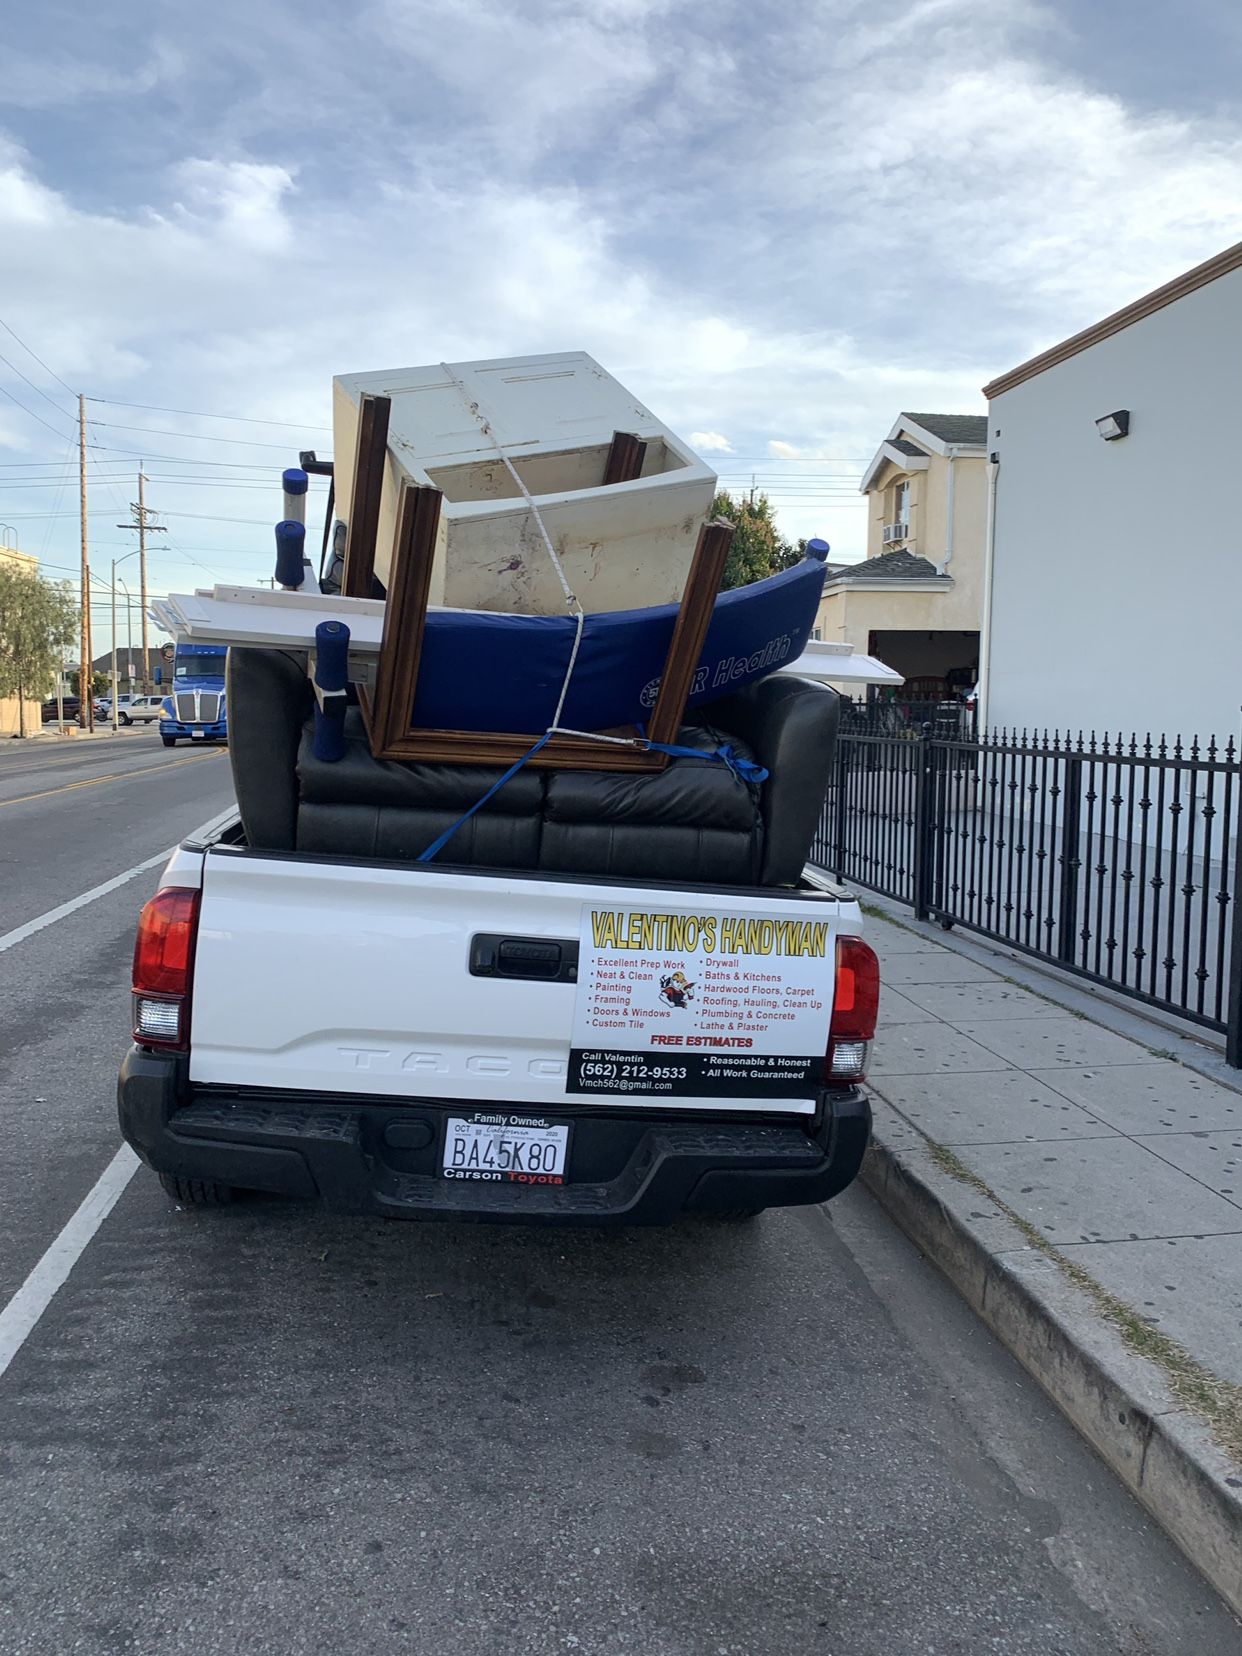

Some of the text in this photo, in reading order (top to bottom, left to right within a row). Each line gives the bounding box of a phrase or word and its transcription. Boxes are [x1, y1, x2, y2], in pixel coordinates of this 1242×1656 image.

[689, 666, 709, 695] R
[712, 634, 791, 688] Health
[591, 911, 829, 957] VALENTINO'S HANDYMAN
[597, 957, 686, 970] Excellent Prep Work
[705, 958, 739, 968] Drywall
[596, 970, 653, 980] Neat & Clean
[705, 971, 782, 982] Baths & Kitchens
[595, 982, 632, 993] Painting
[703, 984, 815, 997] Hardwood Floors, Carpet
[594, 994, 631, 1005] Framing
[702, 996, 823, 1010] Roofing, Hauling, Clean Up
[593, 1007, 671, 1017] Doors & Windows
[701, 1009, 796, 1020] Plumbing & Concrete
[592, 1019, 645, 1029] Custom Tile
[700, 1021, 768, 1032] Lathe & Plaster
[650, 1035, 753, 1047] FREE ESTIMATES
[582, 1052, 644, 1063] Call Valentin
[709, 1056, 811, 1067] Reasonable & Honest
[337, 1047, 567, 1080] TACO
[580, 1062, 687, 1079] (562) 212-9533
[707, 1069, 805, 1079] All Work Guaranteed
[579, 1078, 673, 1091] Vmch562@gmail.com
[474, 1113, 545, 1127] Family Owned
[455, 1124, 471, 1133] OCT
[486, 1125, 529, 1138] California
[452, 1138, 557, 1172] BA45K80
[443, 1169, 563, 1184] Carson Toyota
